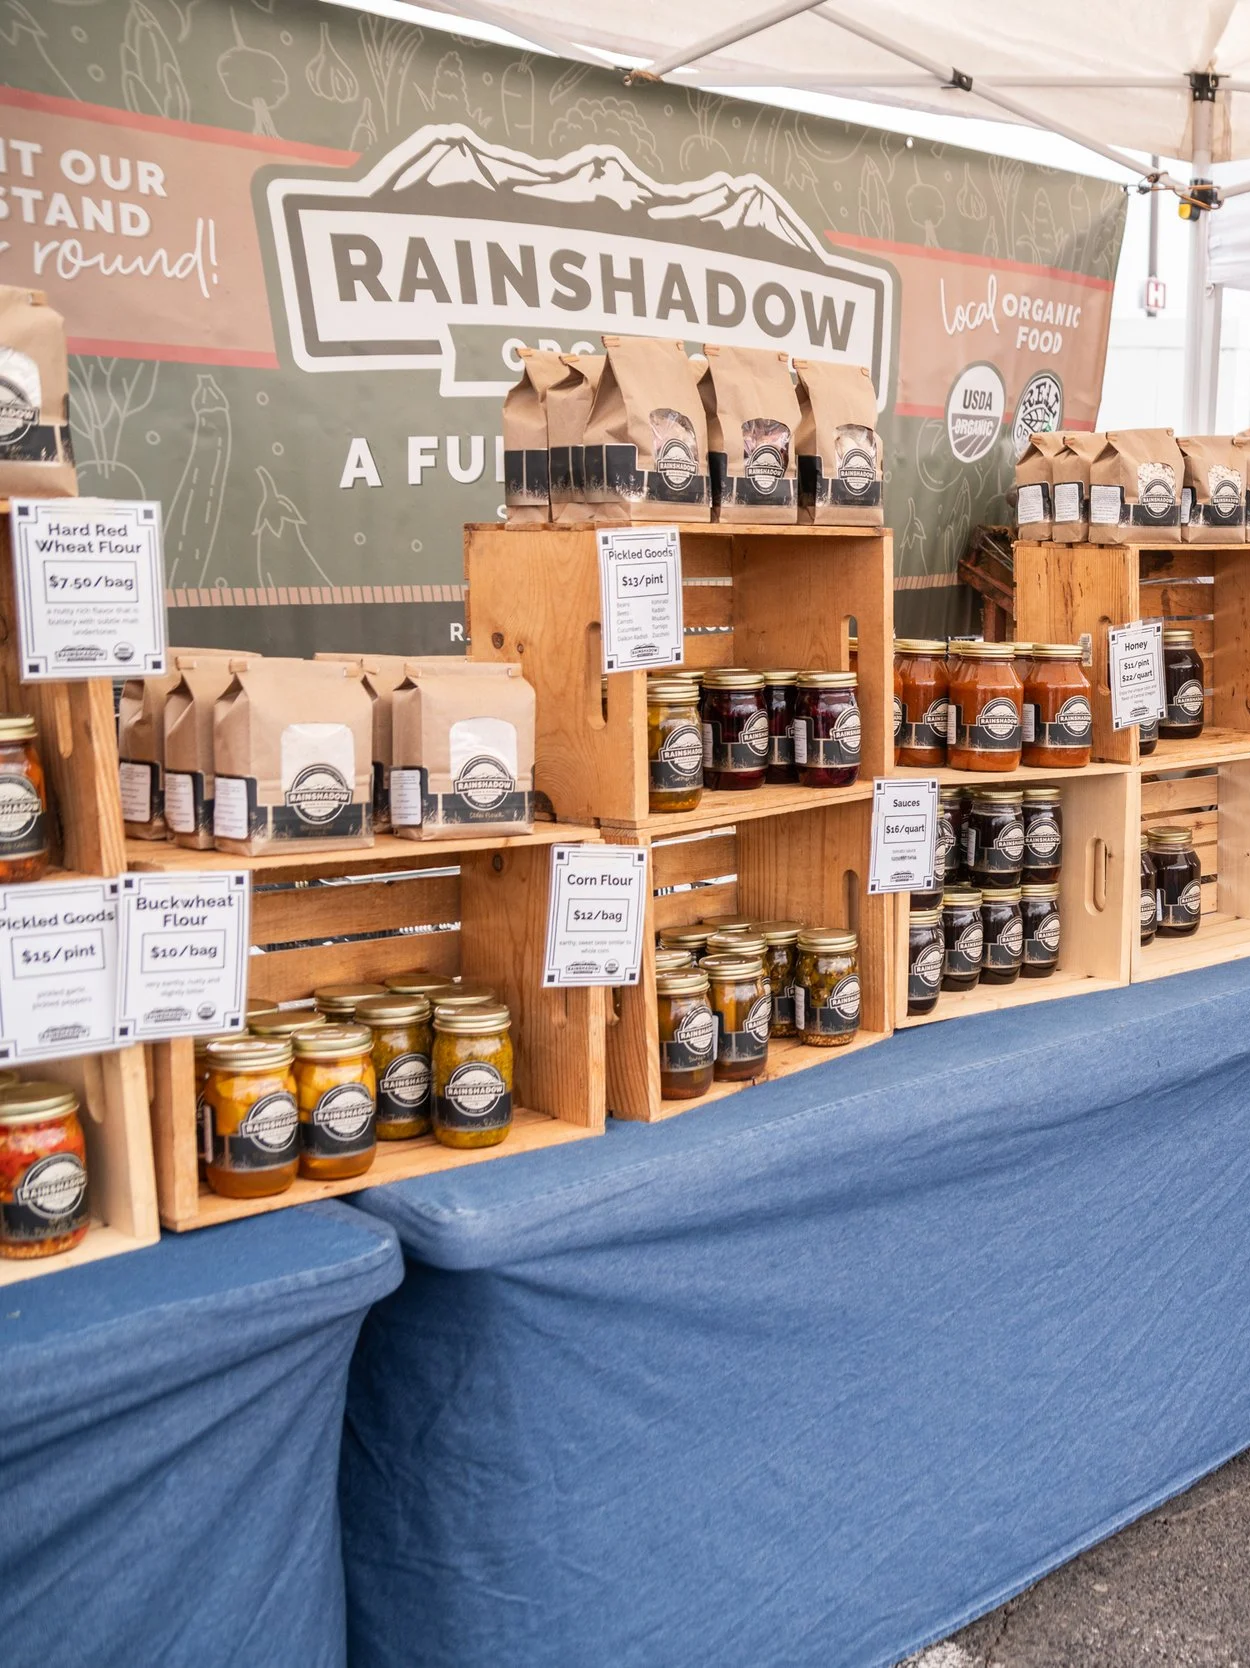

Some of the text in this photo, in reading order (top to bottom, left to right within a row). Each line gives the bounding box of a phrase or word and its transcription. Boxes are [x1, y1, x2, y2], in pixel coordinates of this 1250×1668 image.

[59, 148, 169, 198] OUR
[33, 218, 219, 299] round!
[329, 233, 857, 352] RAINSHADOW
[1002, 292, 1081, 328] ORGANIC
[1015, 326, 1063, 354] FOOD
[963, 389, 993, 411] USDA
[954, 417, 994, 436] ORGANIC
[338, 437, 384, 488] A
[660, 461, 696, 473] RAINSHADOW
[748, 468, 783, 477] RAINSHADOW
[841, 469, 874, 479] RAINSHADOW
[49, 523, 128, 537] Hard Red
[36, 540, 142, 554] Wheat Flour
[608, 548, 673, 561] Pickled Goods
[49, 576, 134, 590] $7.50/bag
[622, 574, 664, 587] $13/pint
[632, 648, 658, 656] RAINSHADOW
[1125, 641, 1148, 652] Honey
[1124, 659, 1150, 670] $11/pint
[1122, 670, 1153, 682] $22/quart
[458, 781, 511, 790] RAINSHADOW
[289, 792, 349, 802] RAINSHADOW
[893, 799, 920, 808] Sauces
[886, 824, 925, 835] $16/quart
[567, 874, 633, 886] Corn Flour
[135, 895, 234, 911] Buckwheat
[64, 909, 115, 924] Goods
[163, 914, 208, 927] Flour
[573, 910, 623, 923] $12/bag
[22, 944, 96, 965] $15/pint
[151, 944, 218, 958] $10/bag
[448, 1086, 503, 1096] RAINSHADOW
